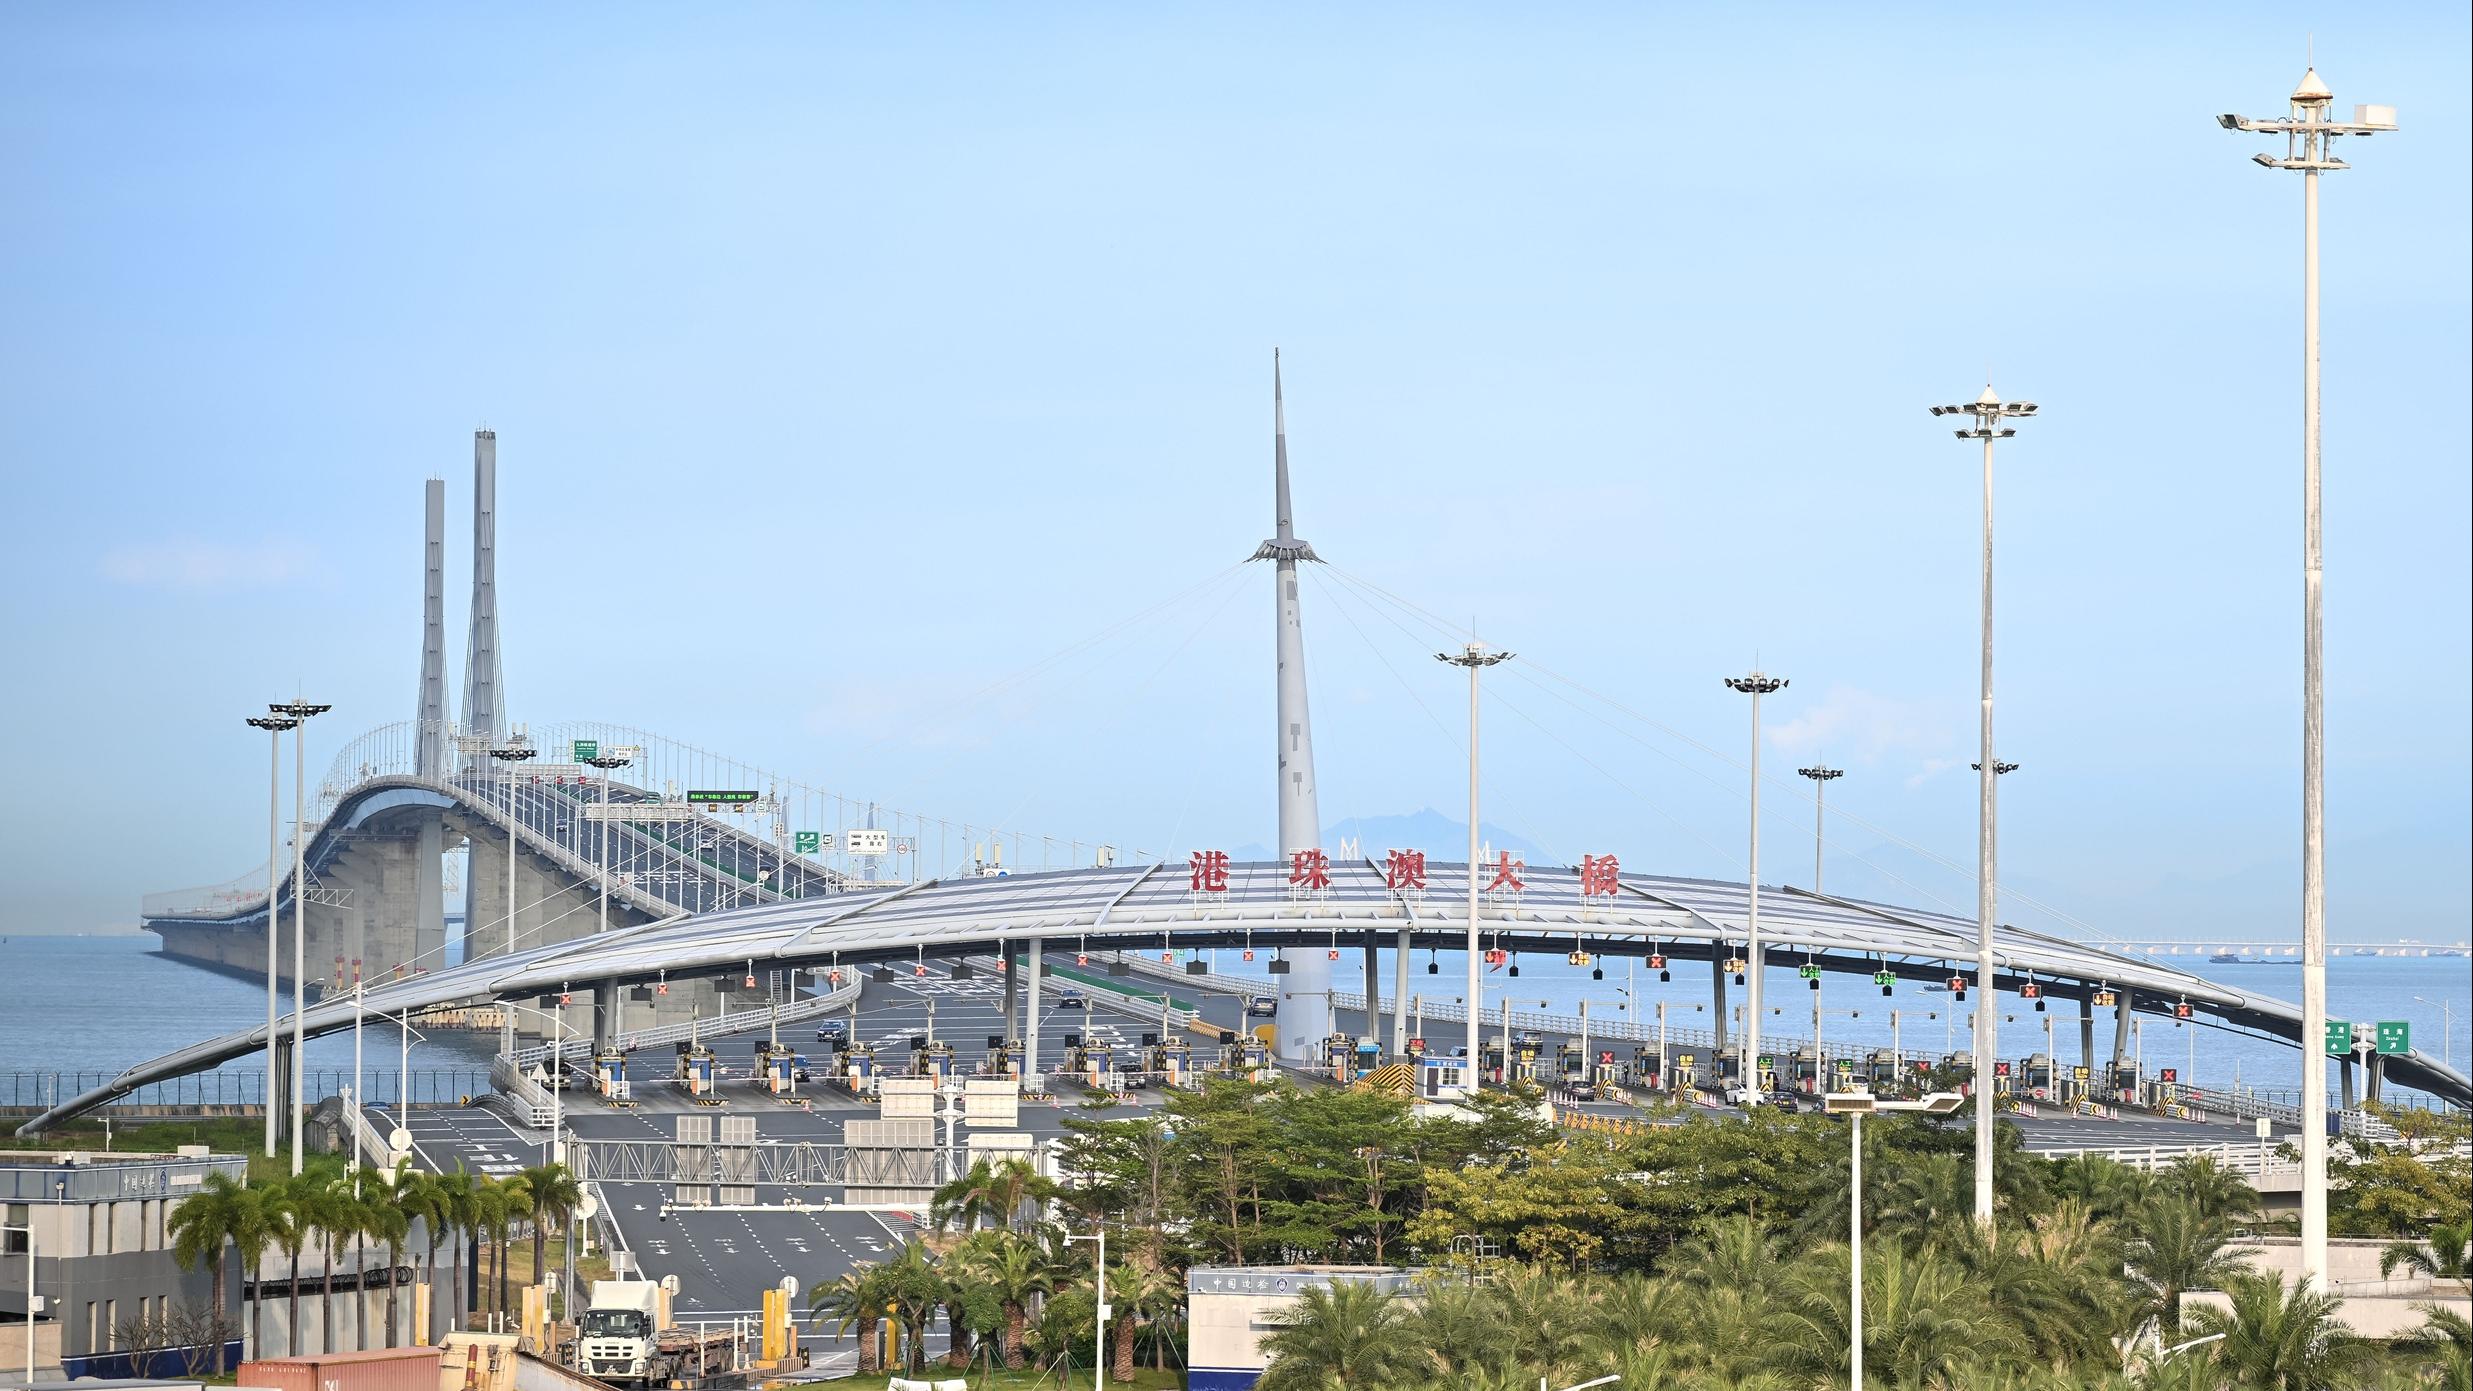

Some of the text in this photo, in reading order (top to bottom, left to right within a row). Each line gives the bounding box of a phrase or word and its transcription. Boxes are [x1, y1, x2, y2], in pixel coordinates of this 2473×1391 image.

[1189, 848, 1620, 896] 港珠澳大橋
[1213, 1277, 1269, 1290] 中国边检
